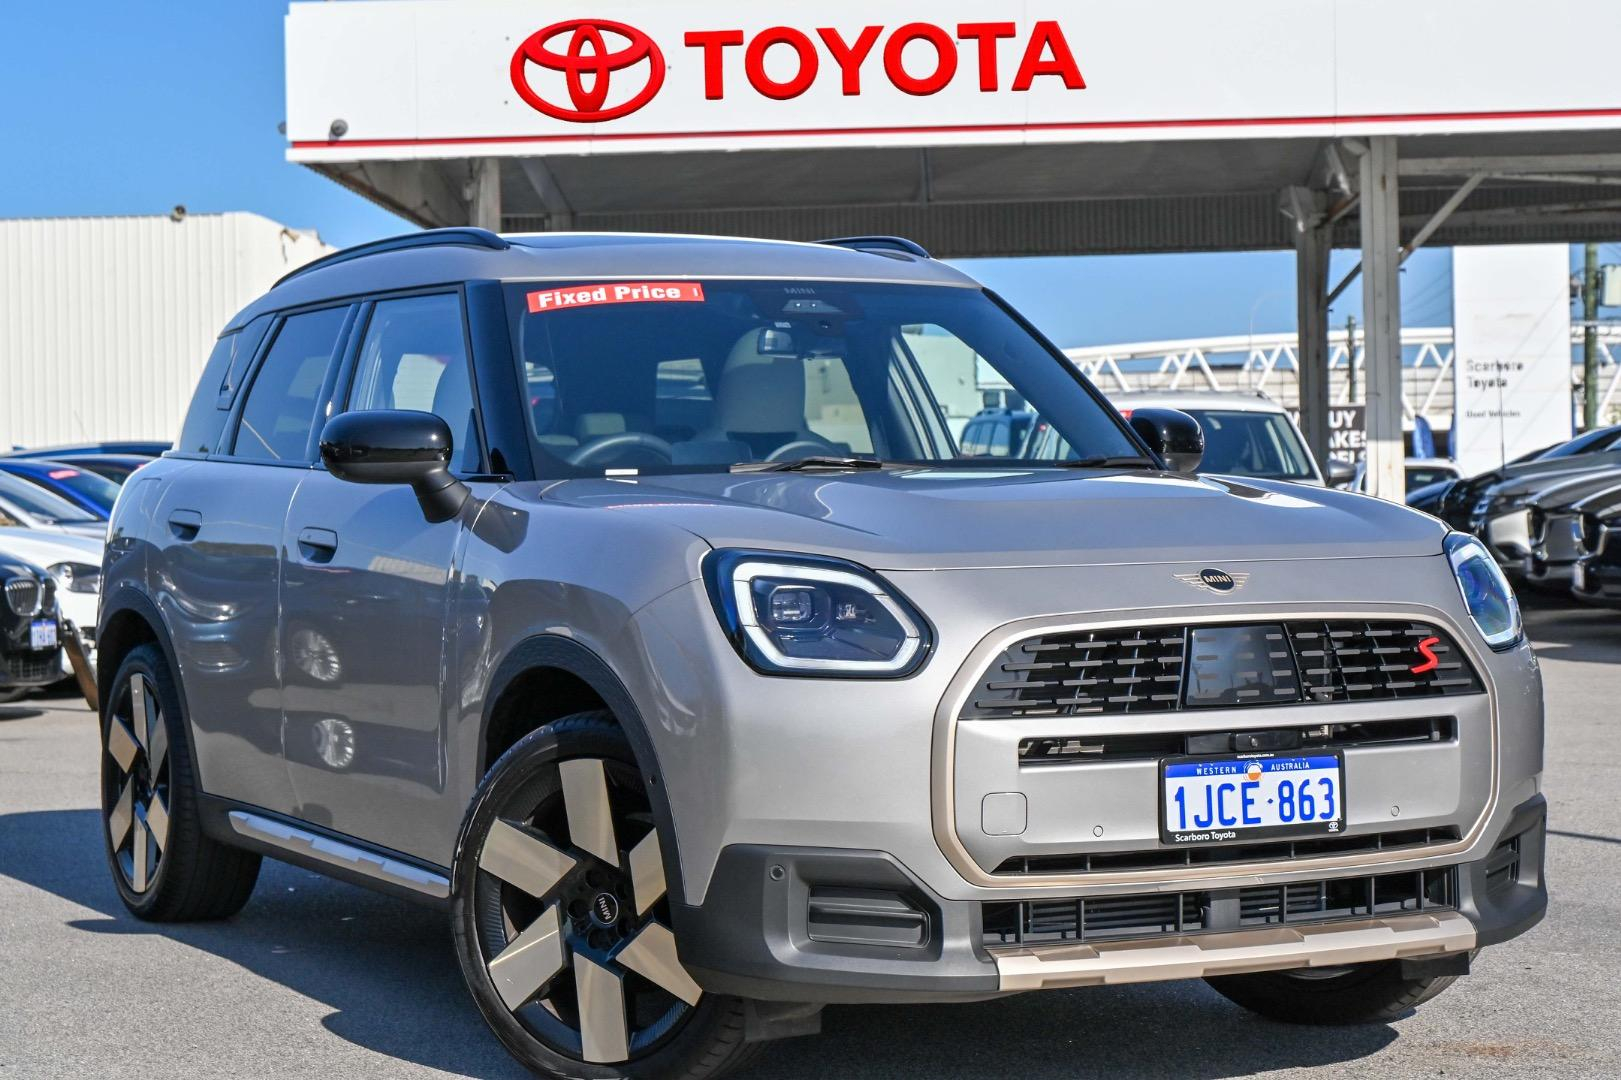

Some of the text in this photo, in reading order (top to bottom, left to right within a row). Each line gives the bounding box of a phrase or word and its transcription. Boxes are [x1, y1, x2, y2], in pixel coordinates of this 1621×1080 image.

[684, 20, 1087, 101] TOYOTA
[538, 285, 681, 308] Fixed Price
[1328, 410, 1357, 428] UY
[1203, 575, 1232, 583] MINI
[1411, 637, 1440, 674] S
[1196, 761, 1310, 775] WESTERN AUSTRALIA
[1175, 830, 1236, 842] Scarboro Toyota
[599, 897, 612, 920] MINI
